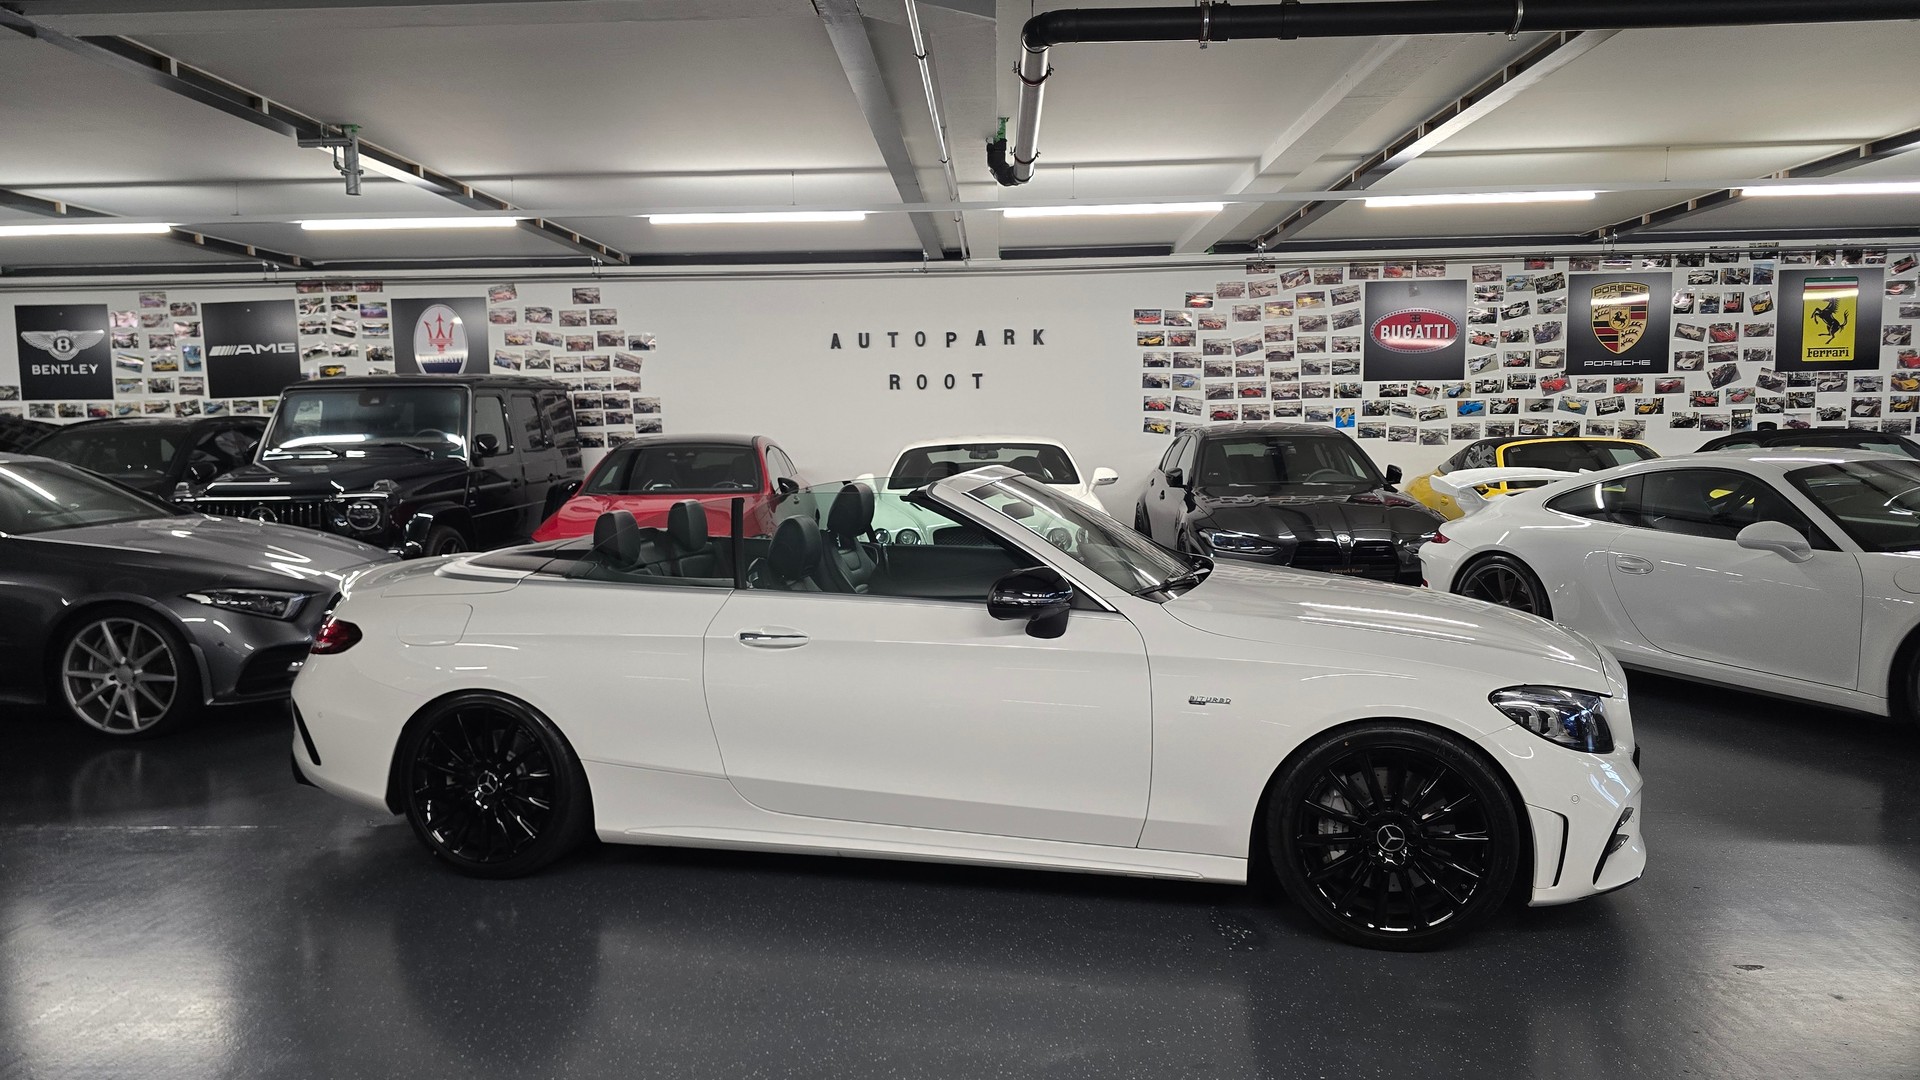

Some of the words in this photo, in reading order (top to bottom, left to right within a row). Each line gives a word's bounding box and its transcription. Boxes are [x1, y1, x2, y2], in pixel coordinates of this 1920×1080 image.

[1594, 285, 1646, 296] PORSCHE
[1380, 323, 1449, 340] BUGATTI
[830, 329, 1045, 349] AUTOPARK
[1806, 346, 1849, 358] Ferrari
[31, 363, 98, 375] BENTLEY
[1583, 359, 1651, 367] PORSCHE
[889, 373, 983, 390] ROOT
[1189, 695, 1232, 704] BITURBO
